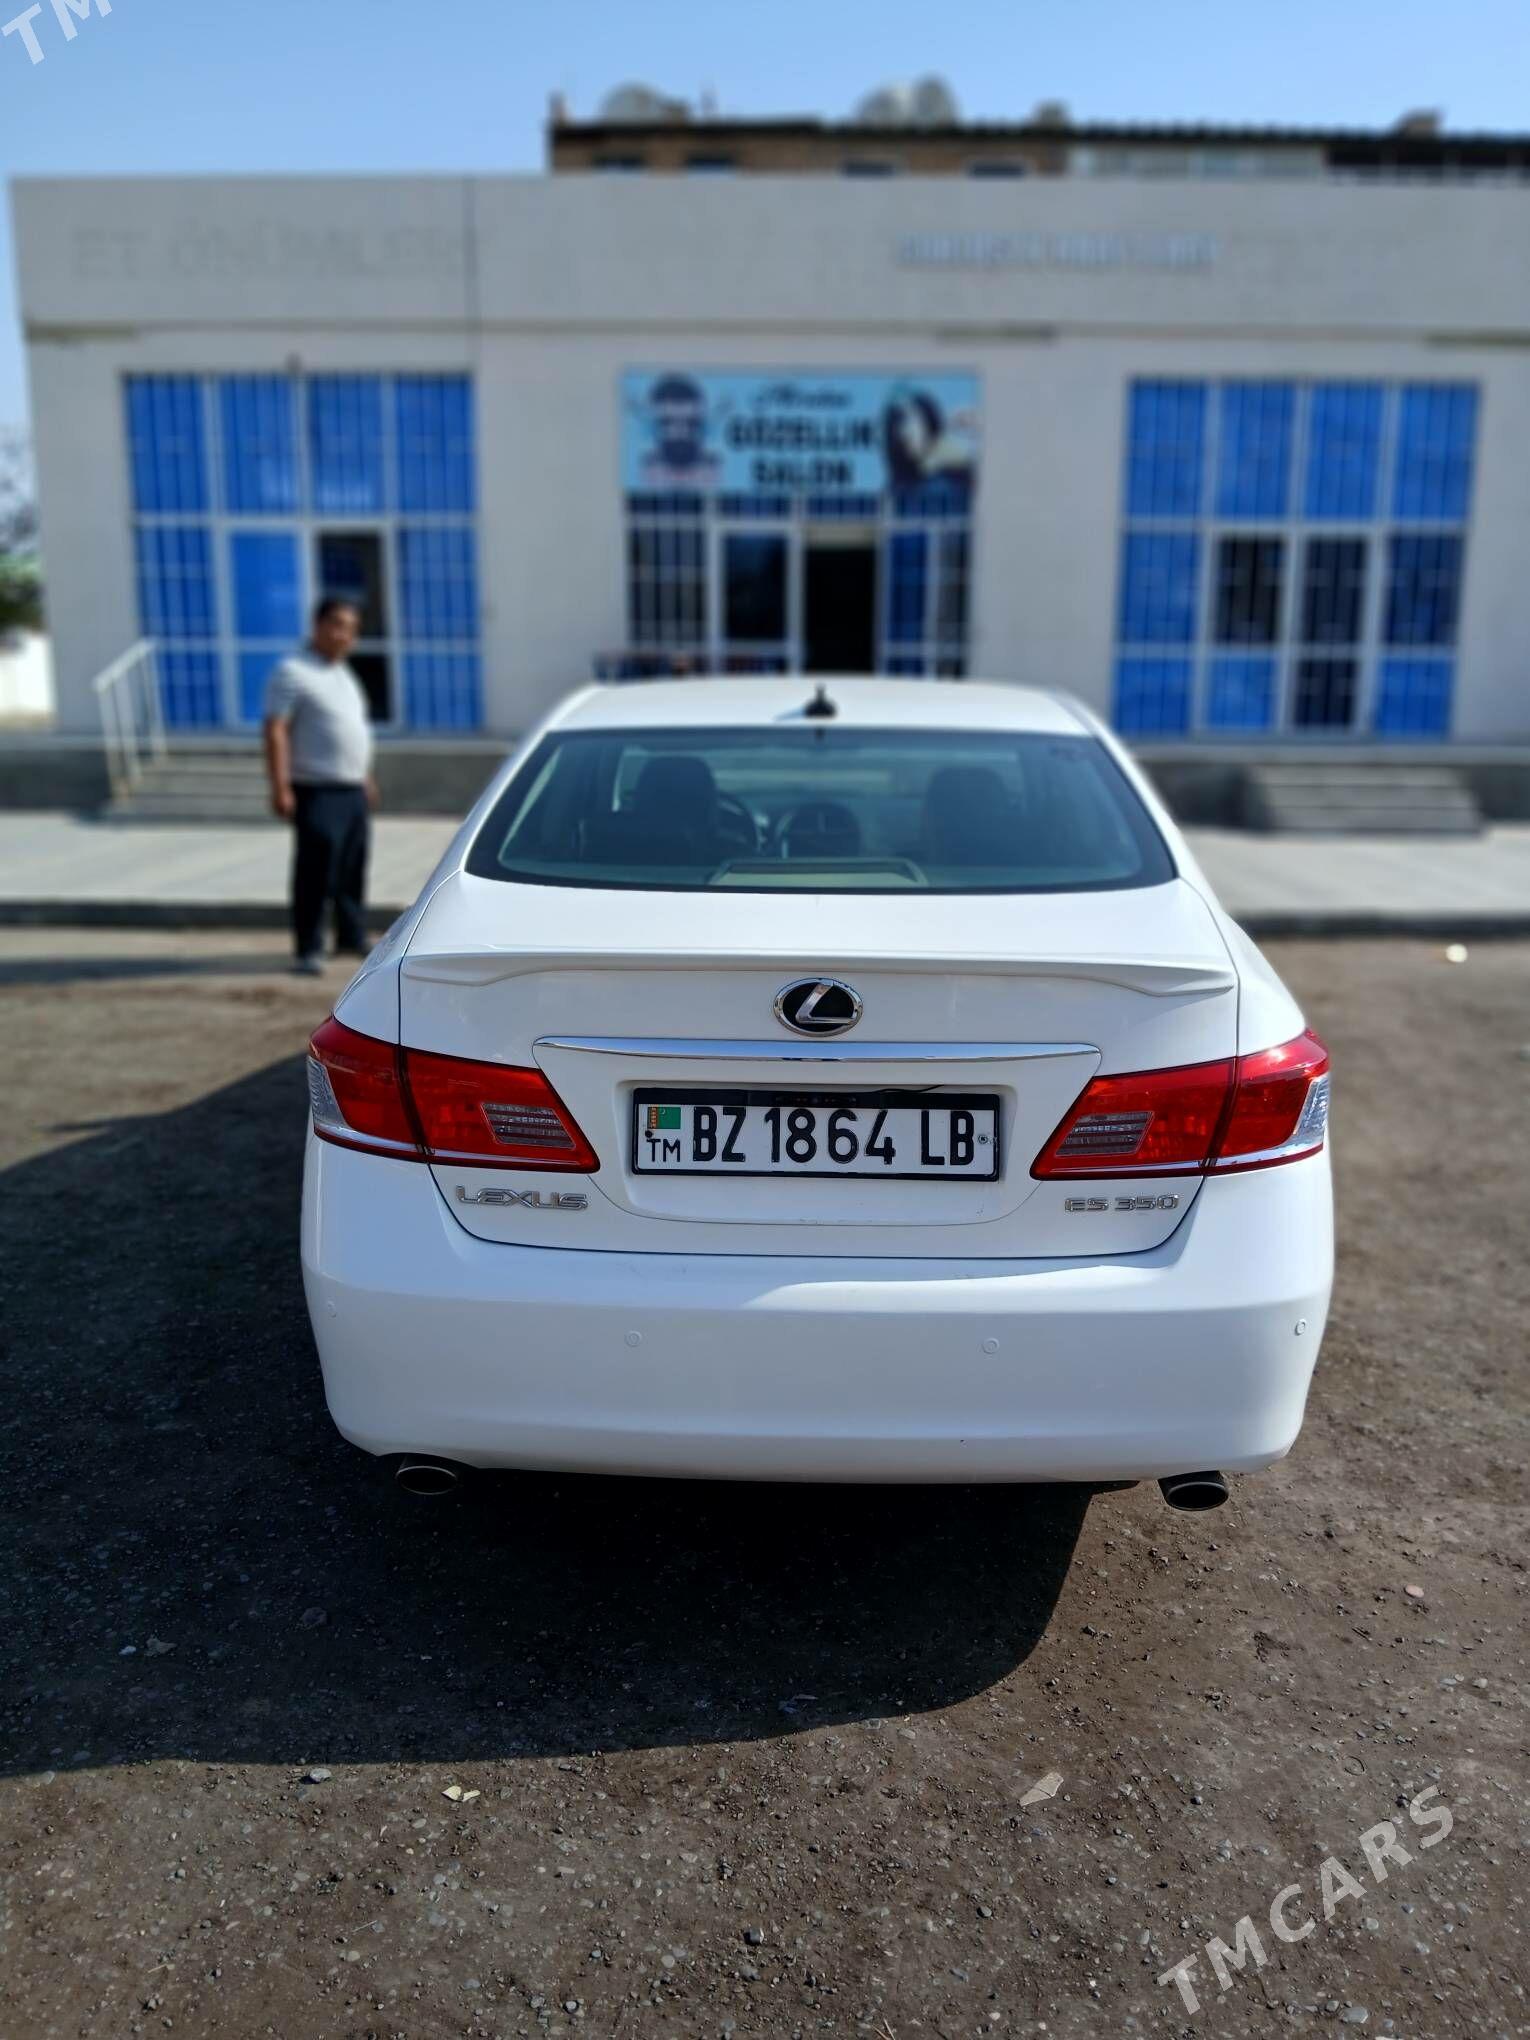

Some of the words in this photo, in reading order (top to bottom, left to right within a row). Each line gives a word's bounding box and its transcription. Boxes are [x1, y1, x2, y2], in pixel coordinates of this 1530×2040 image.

[693, 1106, 746, 1163] BZ
[764, 1107, 897, 1165] 1864
[921, 1110, 975, 1166] LB
[647, 1139, 681, 1163] TM
[456, 1186, 588, 1210] LEXUS
[1065, 1197, 1109, 1212] ES
[1114, 1194, 1179, 1211] 350
